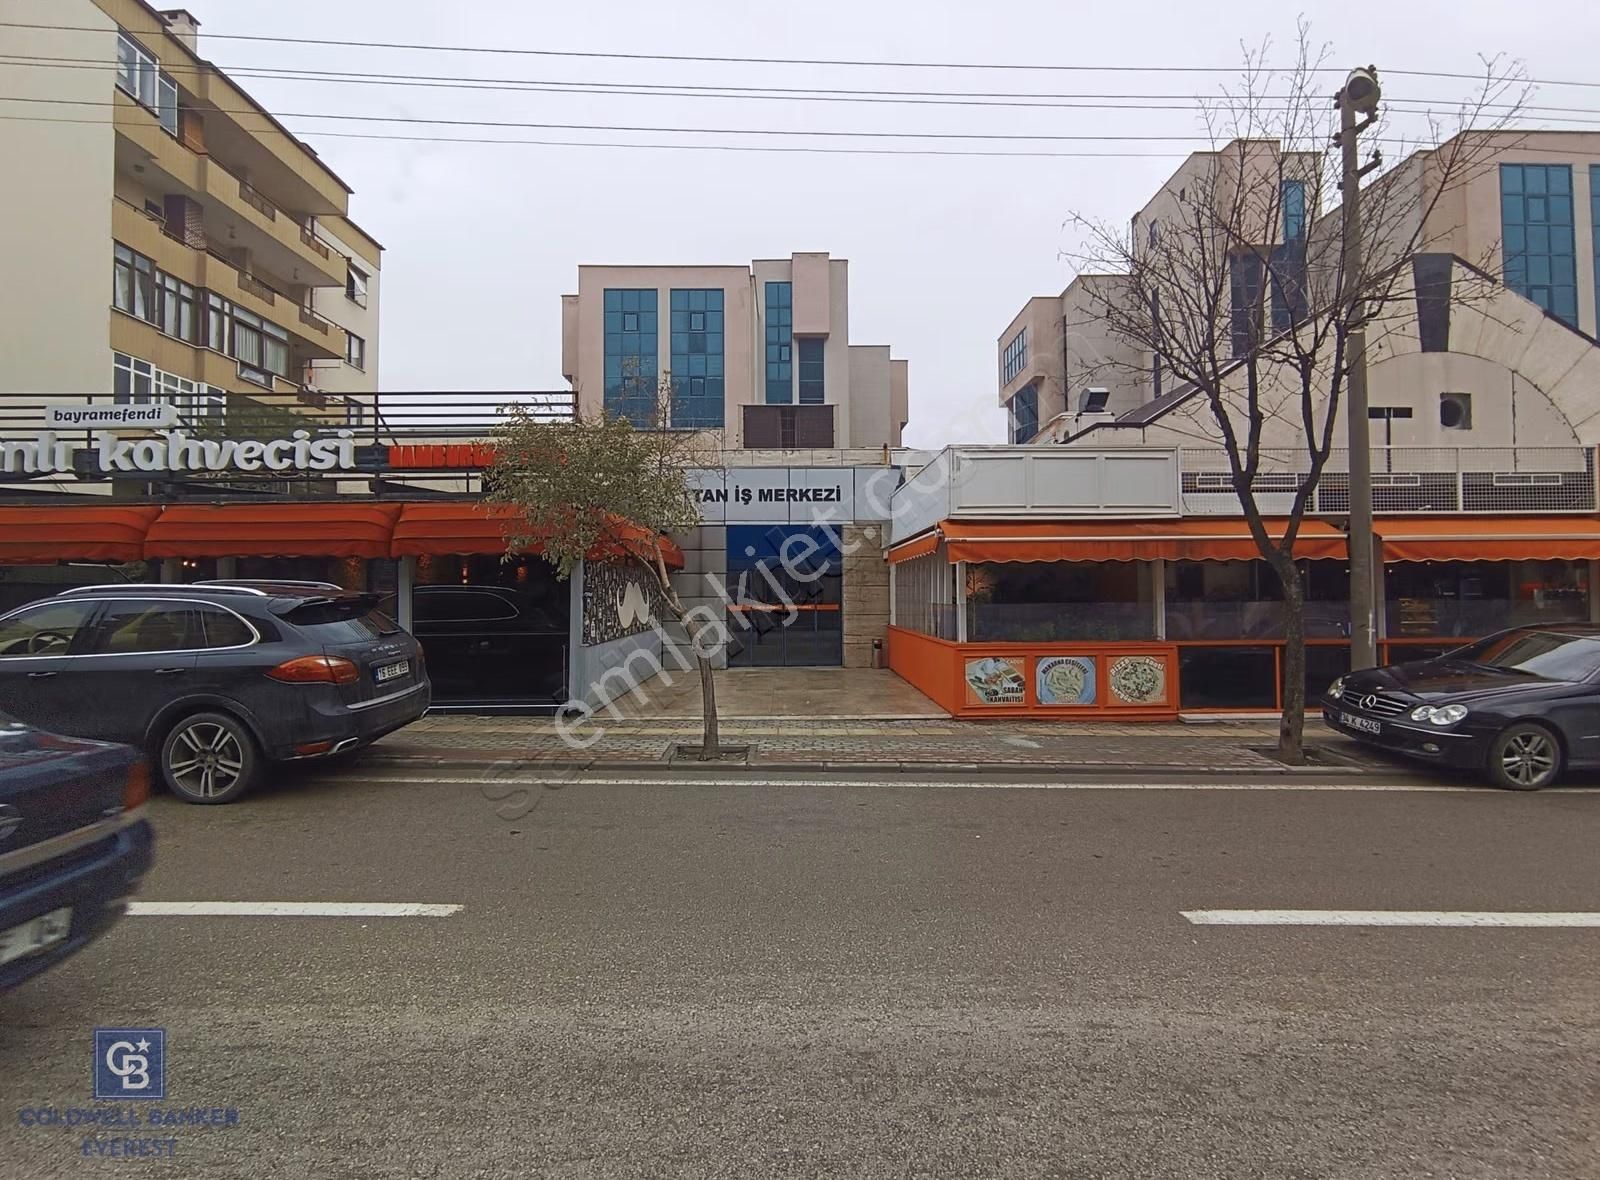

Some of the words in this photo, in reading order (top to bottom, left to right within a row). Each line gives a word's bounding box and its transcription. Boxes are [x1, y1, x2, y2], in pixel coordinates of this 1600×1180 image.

[54, 407, 162, 424] bayramefendi
[0, 430, 76, 473] nlı
[99, 430, 356, 472] kahvecisi
[692, 488, 728, 503] TAN
[735, 485, 752, 505] İŞ
[758, 485, 841, 503] MERKEZİ
